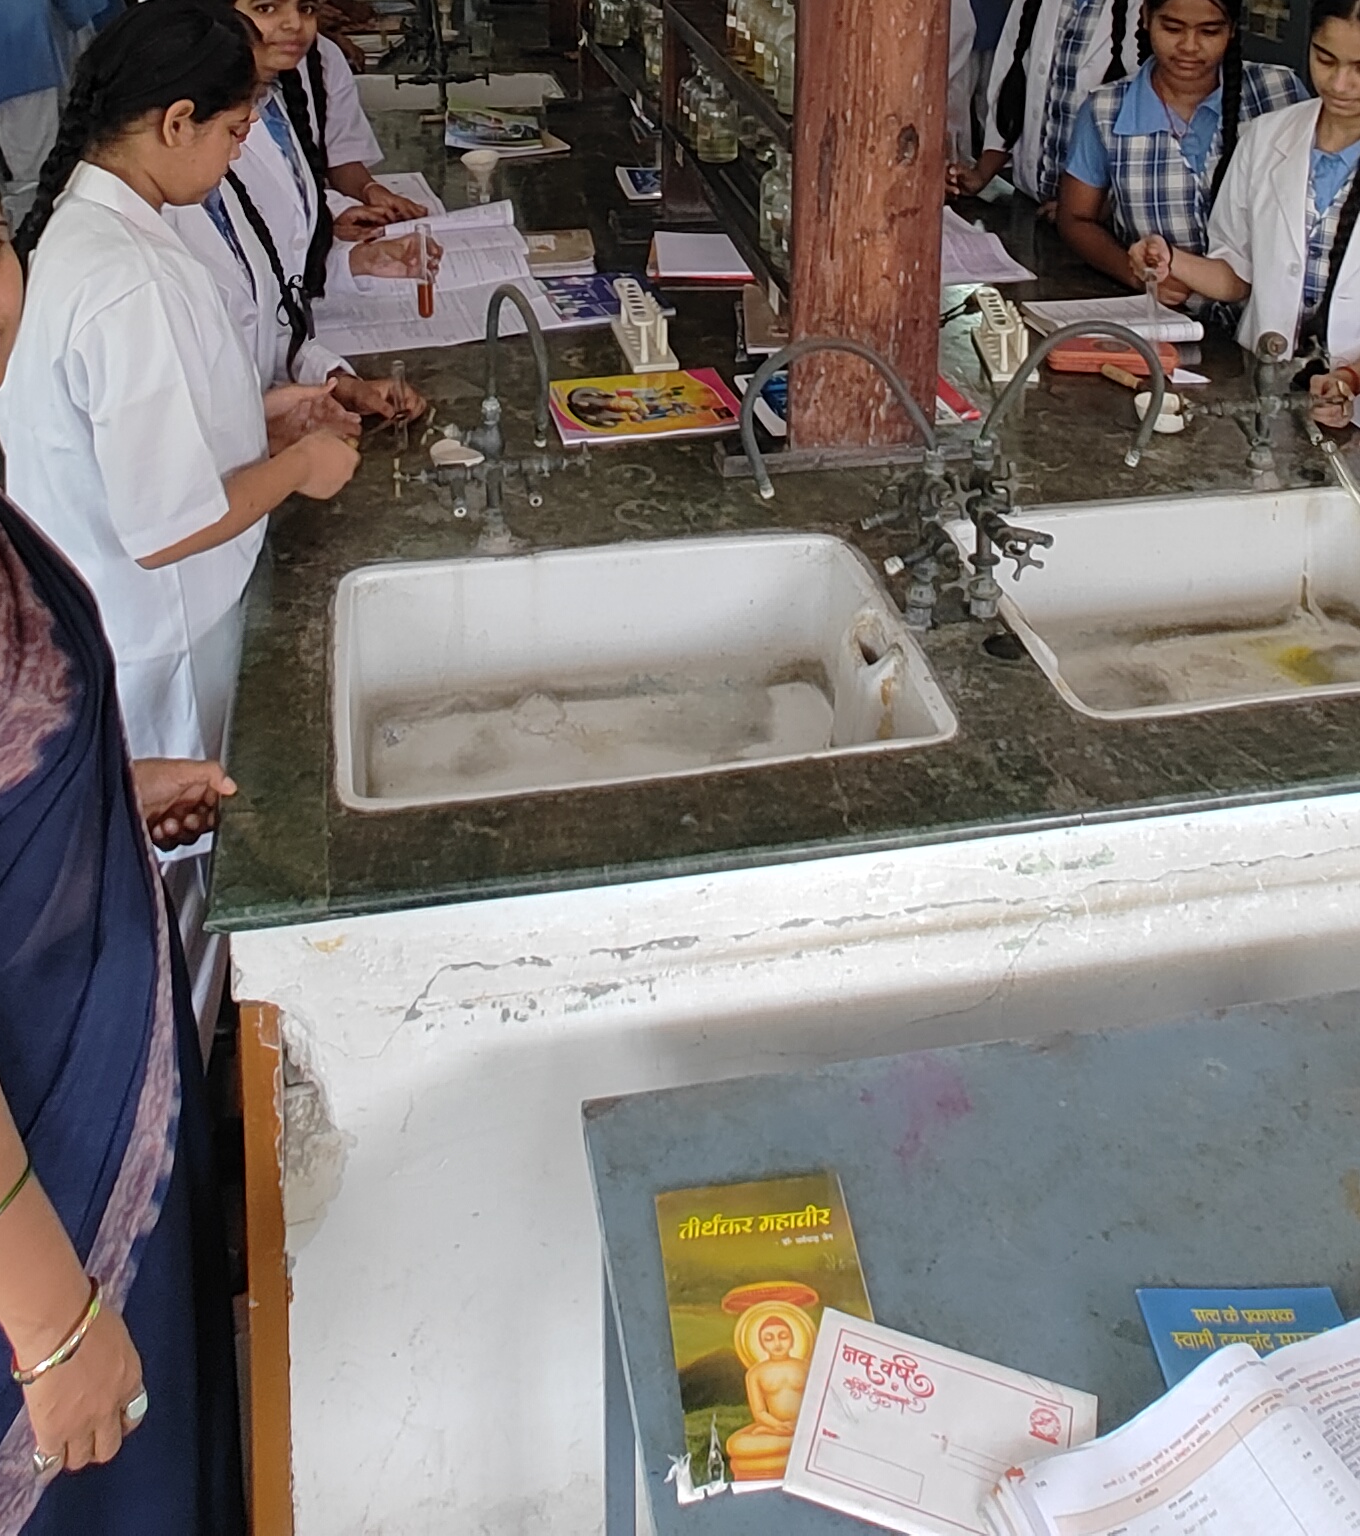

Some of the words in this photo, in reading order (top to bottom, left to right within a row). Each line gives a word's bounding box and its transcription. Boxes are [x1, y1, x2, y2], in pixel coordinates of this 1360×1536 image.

[758, 1204, 831, 1232] महावीर
[1221, 1305, 1240, 1323] के
[1241, 1309, 1297, 1324] प्रकाशक
[1170, 1328, 1216, 1350] स्वामी
